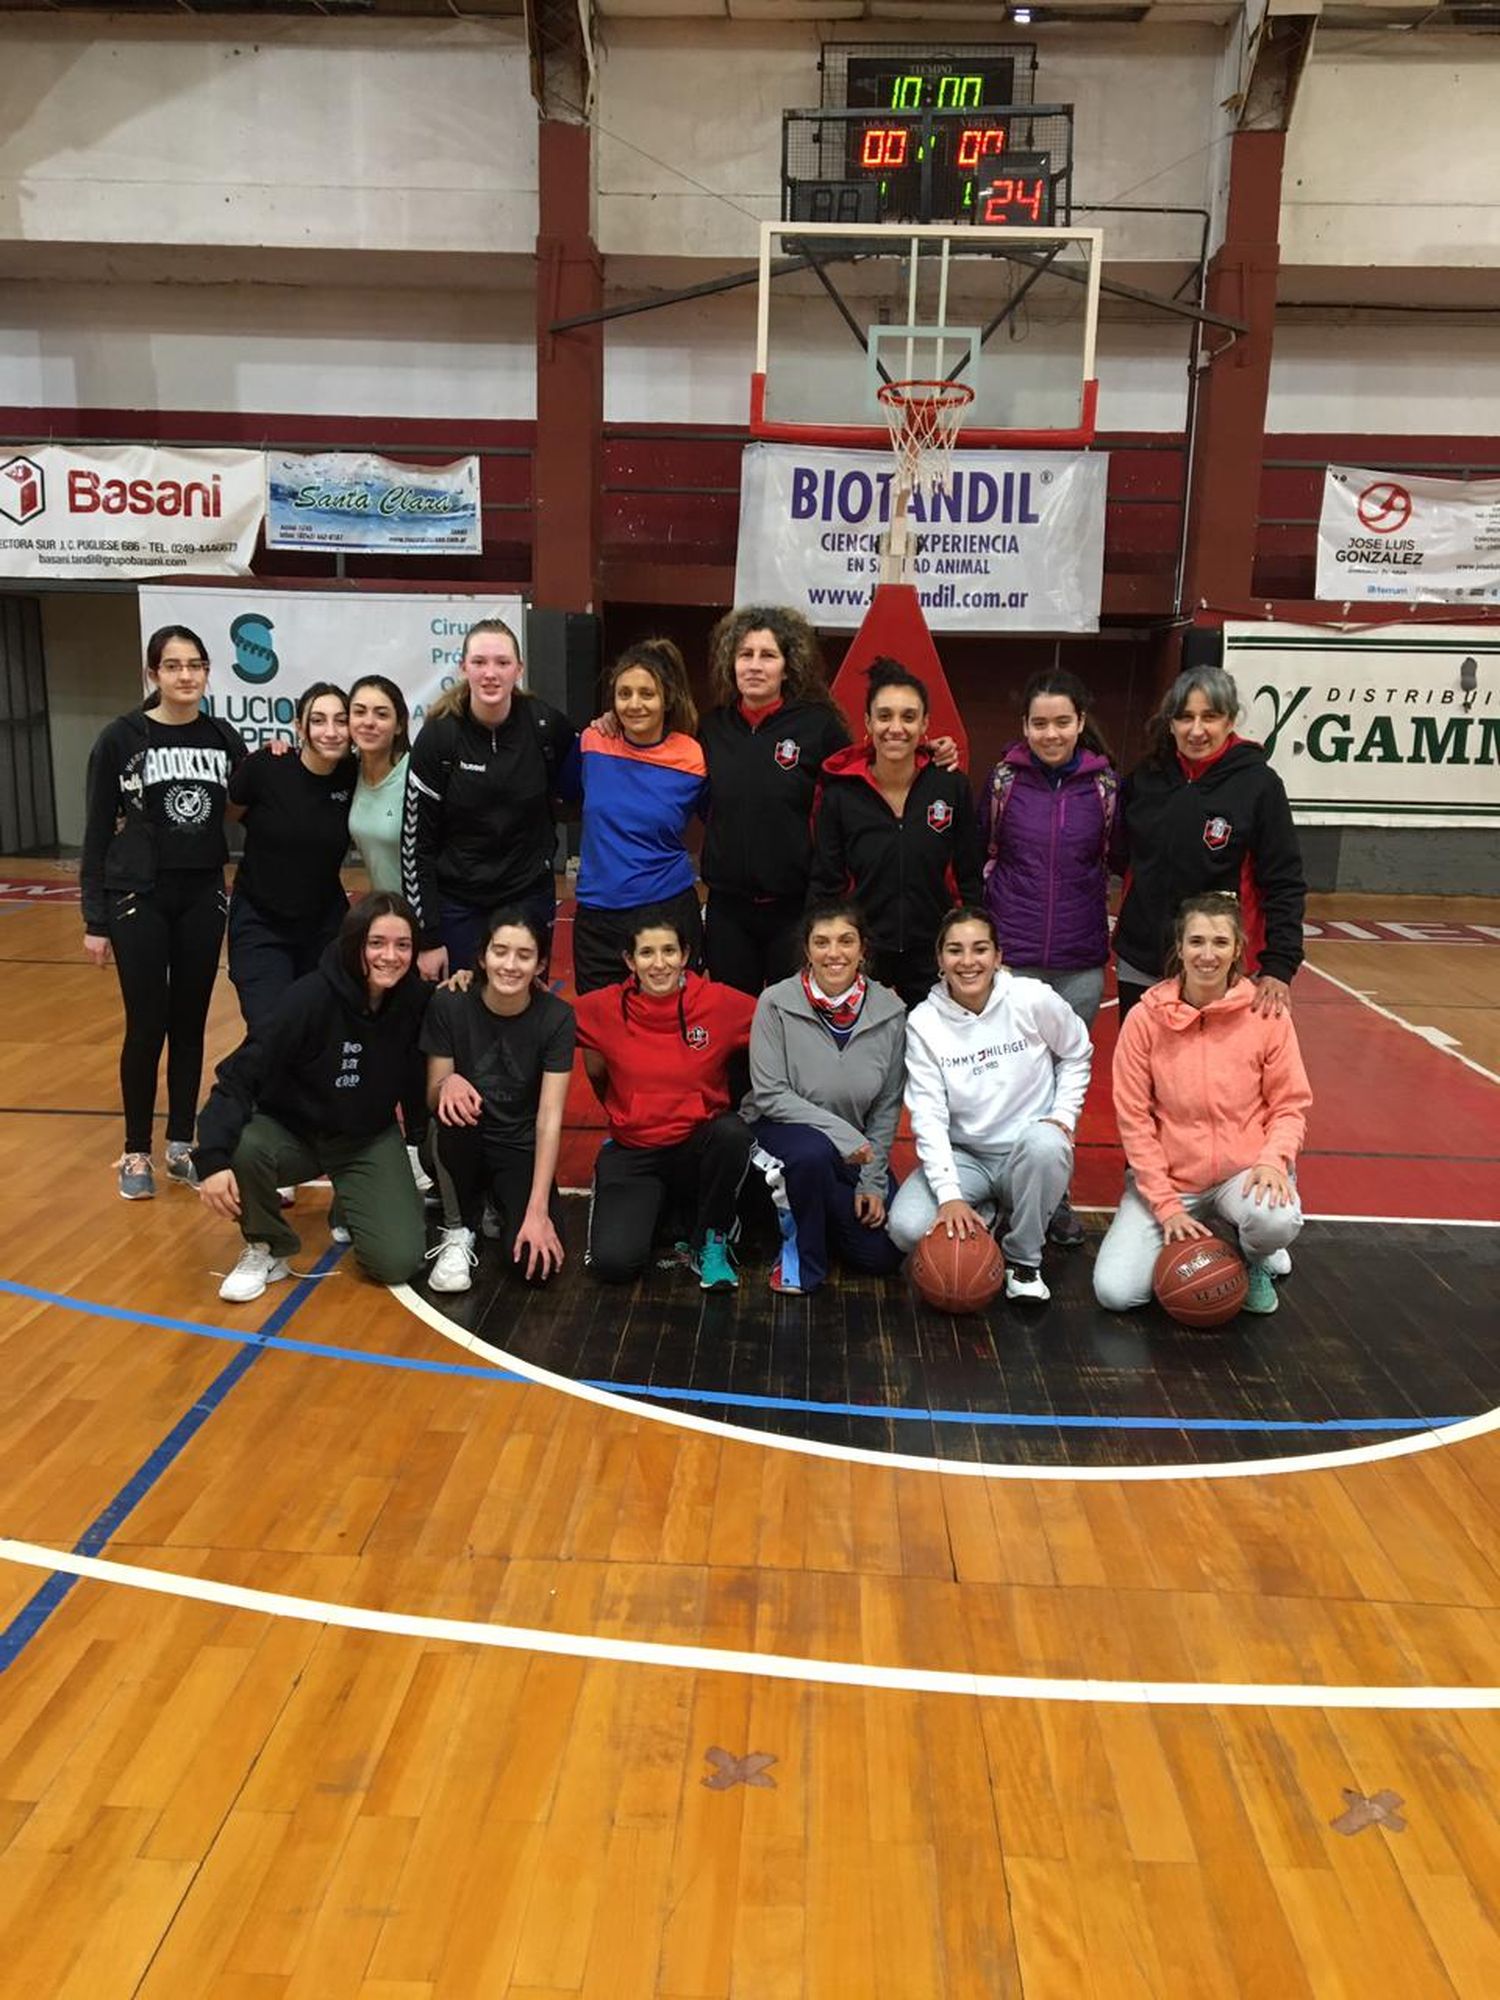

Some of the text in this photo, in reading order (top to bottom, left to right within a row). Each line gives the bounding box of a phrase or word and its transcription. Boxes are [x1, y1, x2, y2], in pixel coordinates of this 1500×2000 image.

[863, 131, 906, 164] 00
[983, 178, 1044, 222] 24
[67, 469, 222, 518] Basani
[294, 485, 452, 515] Santa Clara
[36, 539, 56, 550] SUR
[77, 540, 120, 551] PUGLIESE
[820, 533, 1020, 554] CIENCI XPERIENCIA
[1348, 537, 1416, 552] JOSE LUIS
[847, 557, 865, 573] EN
[935, 559, 991, 574] ANIMAL
[1335, 549, 1425, 565] GONZALEZ
[431, 619, 475, 636] Ciru
[1326, 687, 1496, 706] DISTRIBUI
[459, 760, 487, 773] hummel
[940, 1053, 976, 1068] TOMMY
